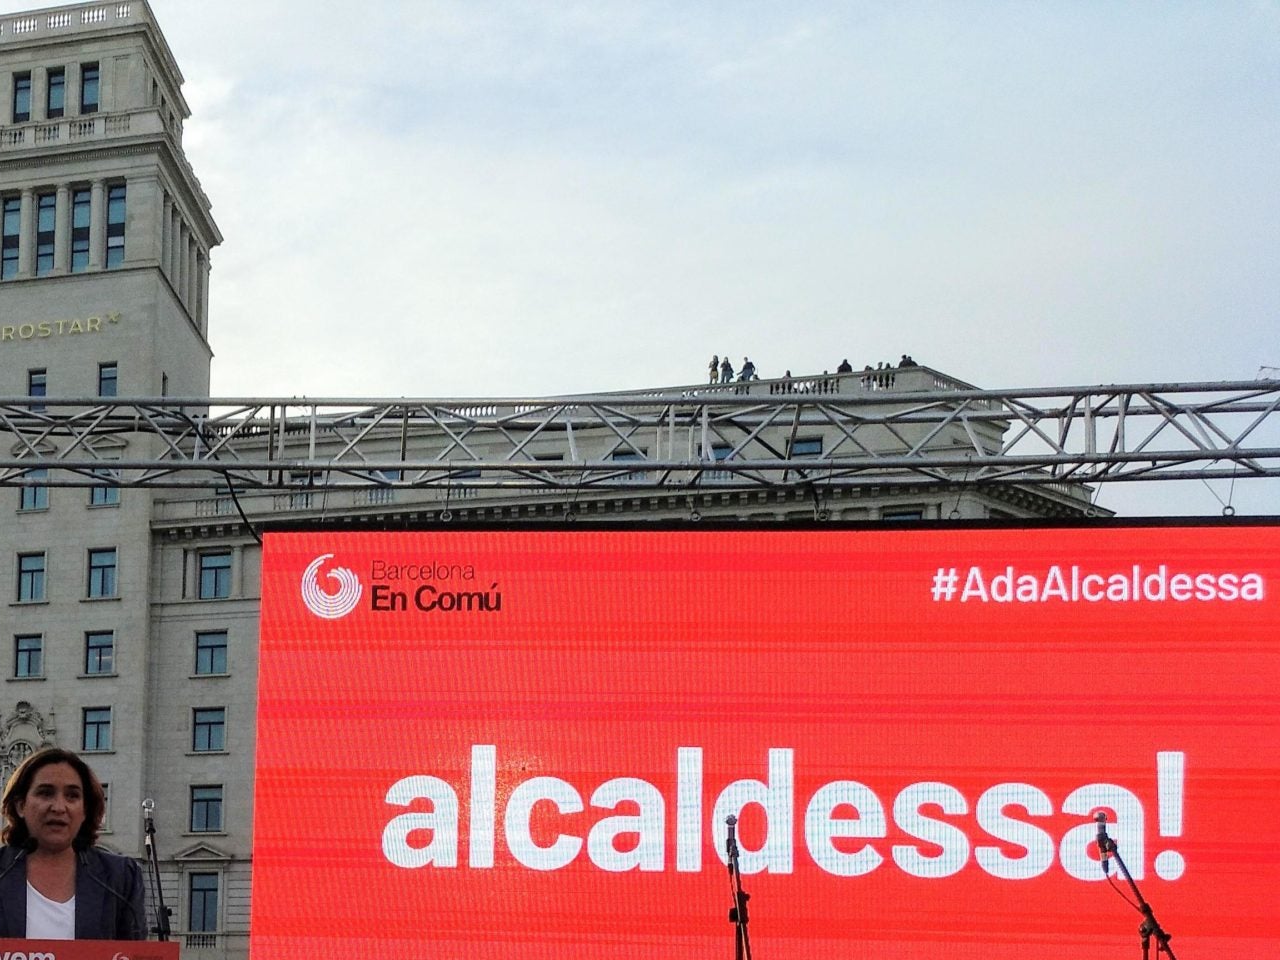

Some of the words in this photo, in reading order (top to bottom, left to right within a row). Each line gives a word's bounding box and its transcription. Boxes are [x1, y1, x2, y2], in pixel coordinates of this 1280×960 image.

[371, 560, 475, 581] Barcelona
[930, 565, 1264, 603] #AdaAlcaldessa
[371, 585, 407, 612] En
[414, 583, 502, 612] Comú
[381, 745, 1186, 882] alcaldessa!
